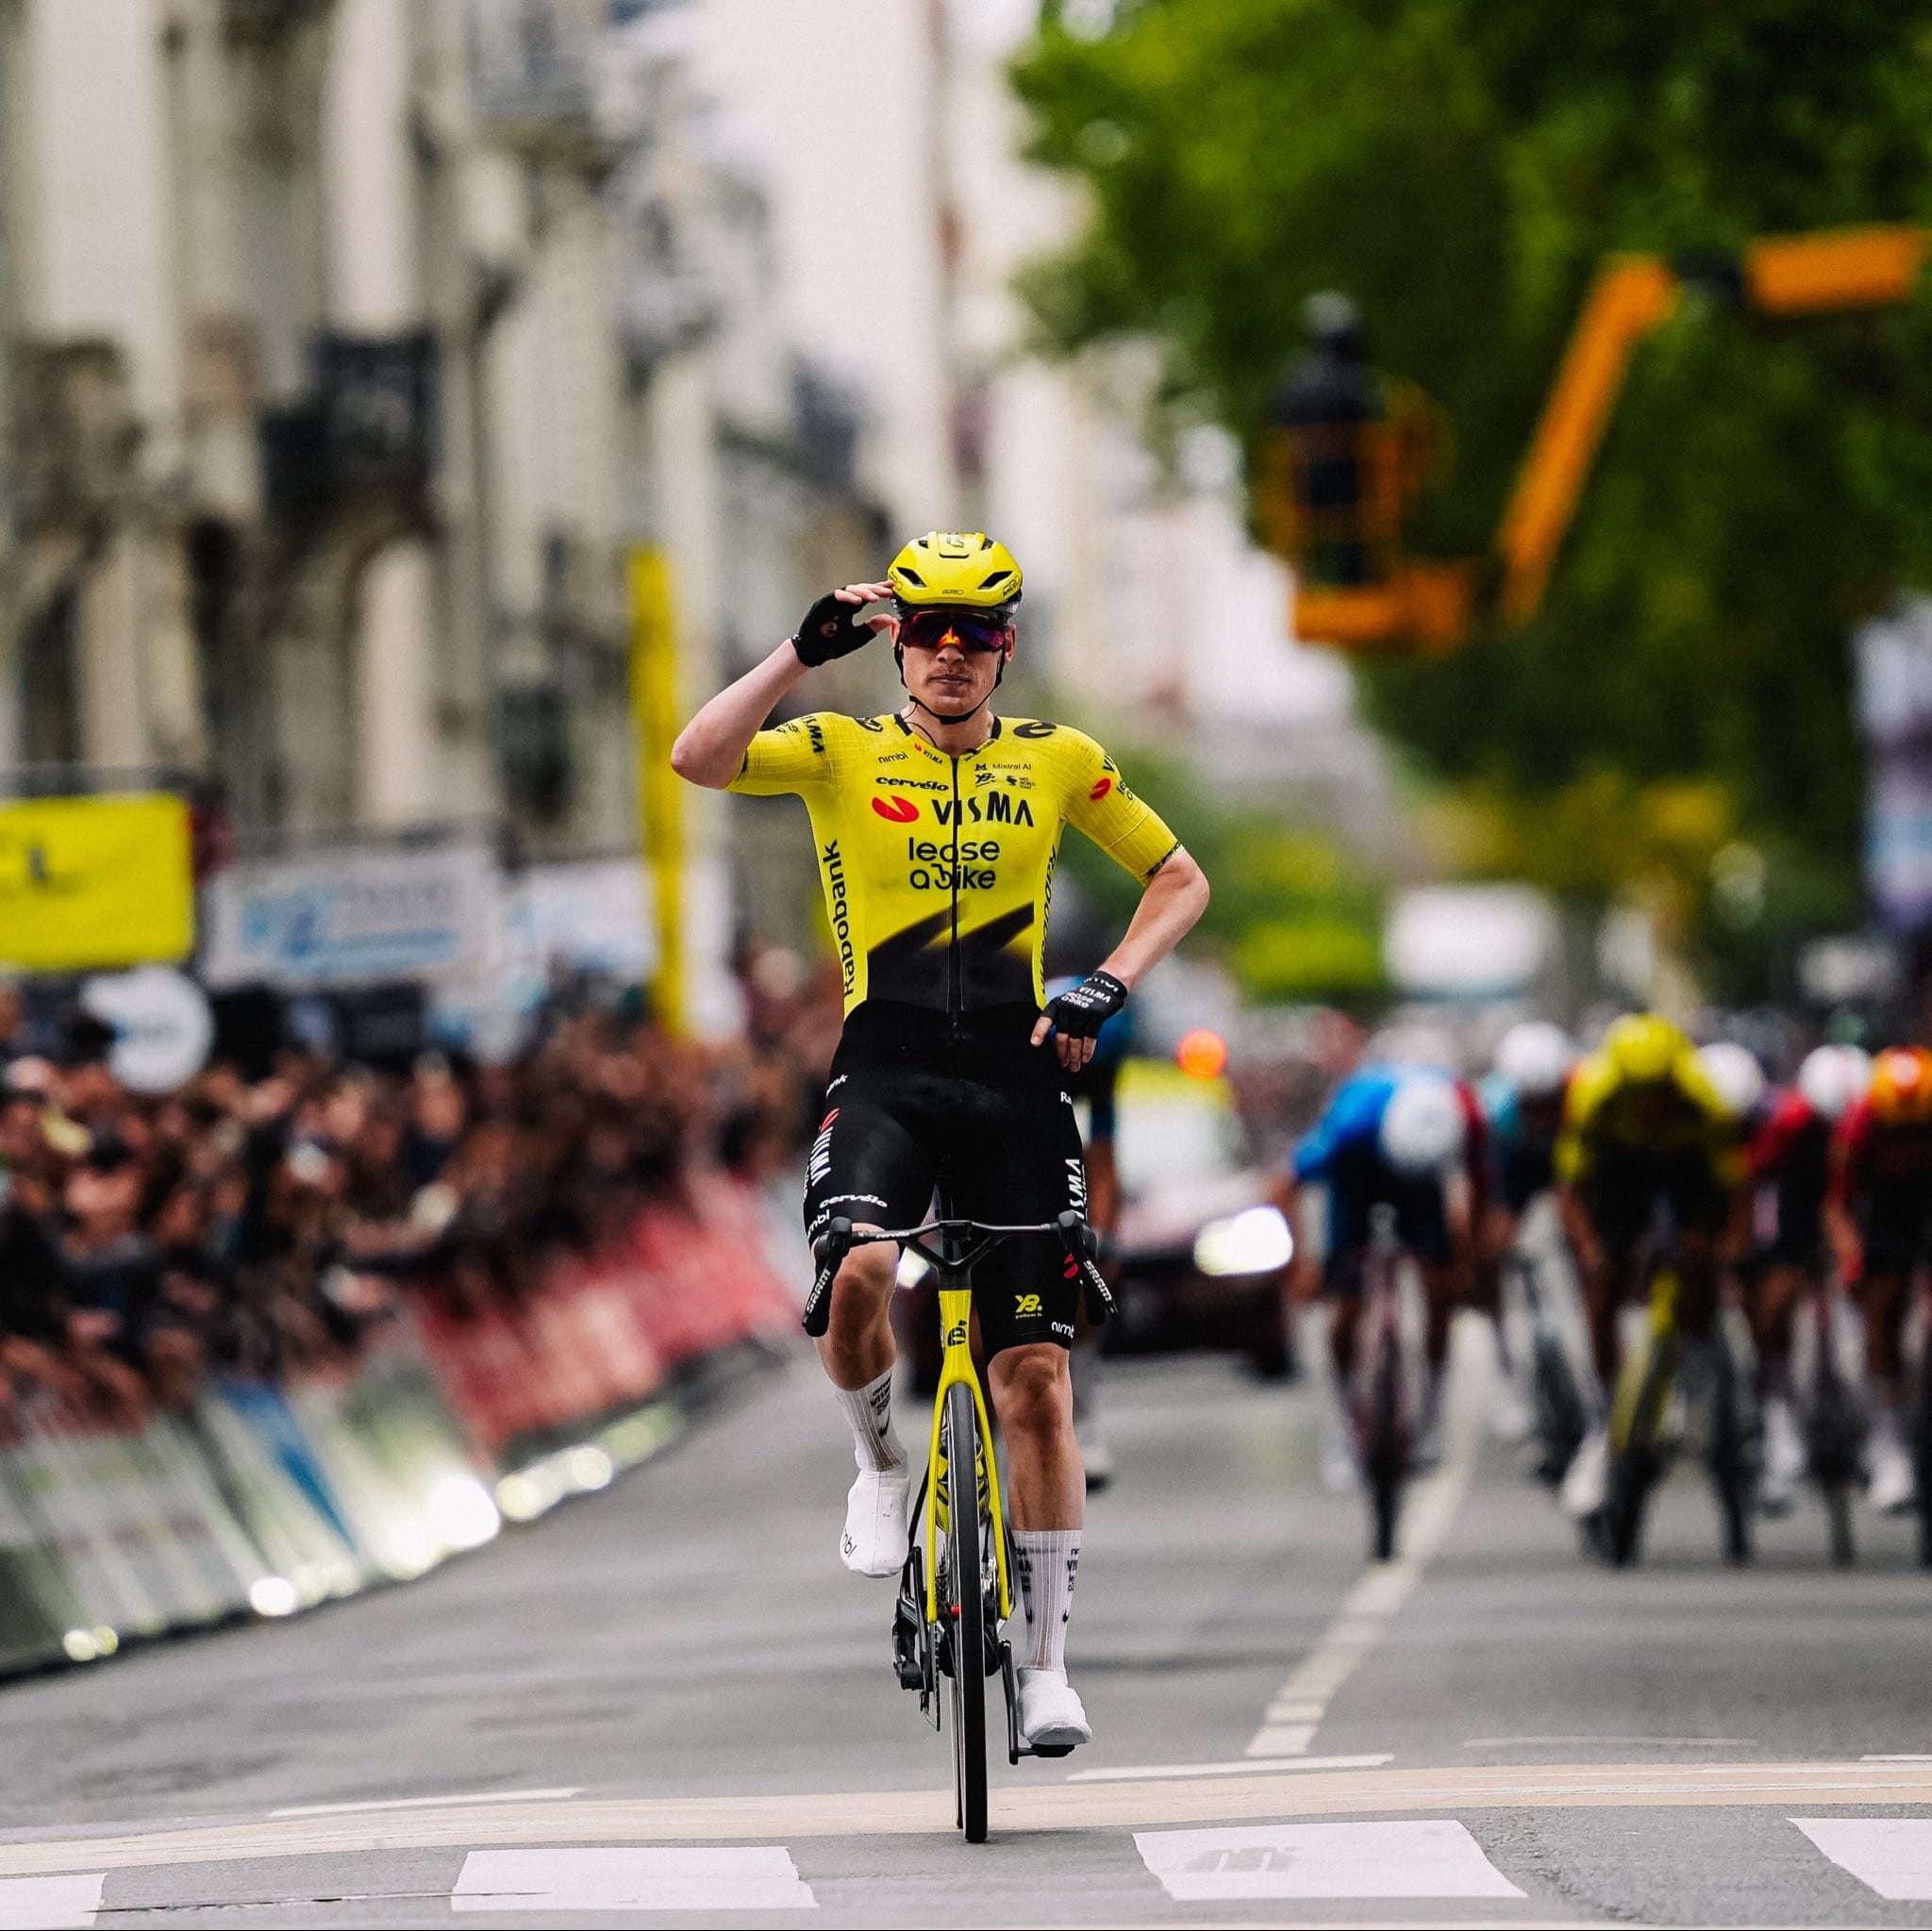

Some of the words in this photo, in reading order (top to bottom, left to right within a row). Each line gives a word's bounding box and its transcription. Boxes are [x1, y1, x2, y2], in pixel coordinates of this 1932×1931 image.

[931, 791, 1034, 827] VISMA
[908, 837, 1000, 863] lease
[823, 839, 856, 996] Rabobank
[807, 1268, 831, 1314] SRAM
[1051, 1321, 1074, 1339] nim
